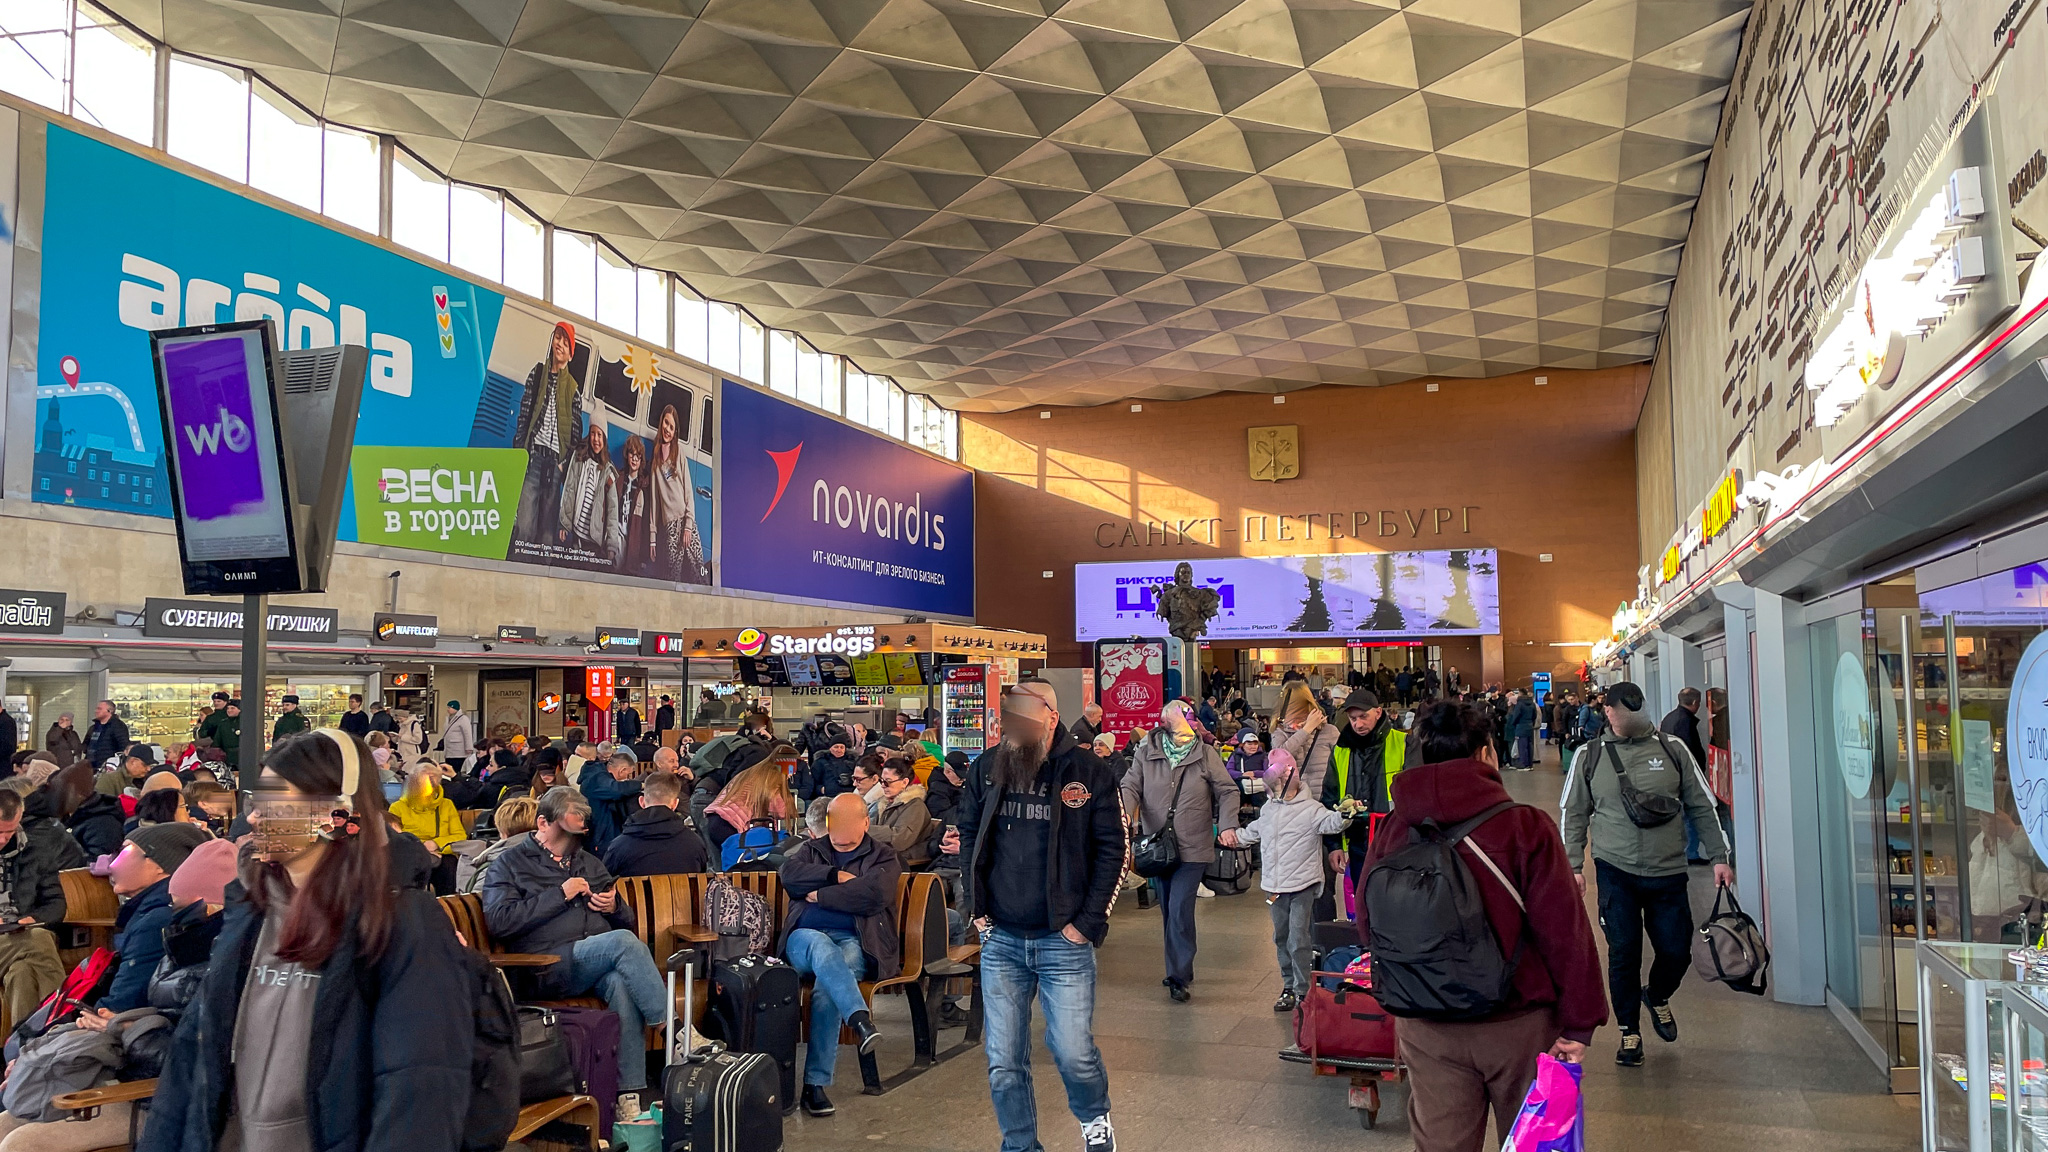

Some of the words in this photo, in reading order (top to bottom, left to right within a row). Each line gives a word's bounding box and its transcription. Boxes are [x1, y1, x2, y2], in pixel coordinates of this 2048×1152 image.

[184, 407, 251, 456] wb
[381, 467, 500, 504] ВЕСНА
[384, 510, 401, 533] в
[410, 508, 500, 540] городе
[812, 479, 946, 551] novardis
[1094, 506, 1481, 549] САНКТ-ПЕТЕРБУРГ
[224, 571, 257, 581] ОЛИМП
[700, 567, 708, 577] 0+
[812, 550, 875, 573] ИТ-КОНСАЛТИНГ
[876, 560, 890, 576] ДЛЯ
[890, 565, 918, 581] ЗРЕЛОГО
[918, 569, 946, 586] БИЗНЕСА
[1116, 576, 1175, 585] ВИКТОР
[1116, 577, 1235, 612] ЦЙ
[668, 638, 683, 652] МТ
[770, 632, 875, 657] Stardogs
[836, 627, 854, 635] est.
[854, 626, 875, 635] 1993
[684, 1097, 693, 1125] PAIKE
